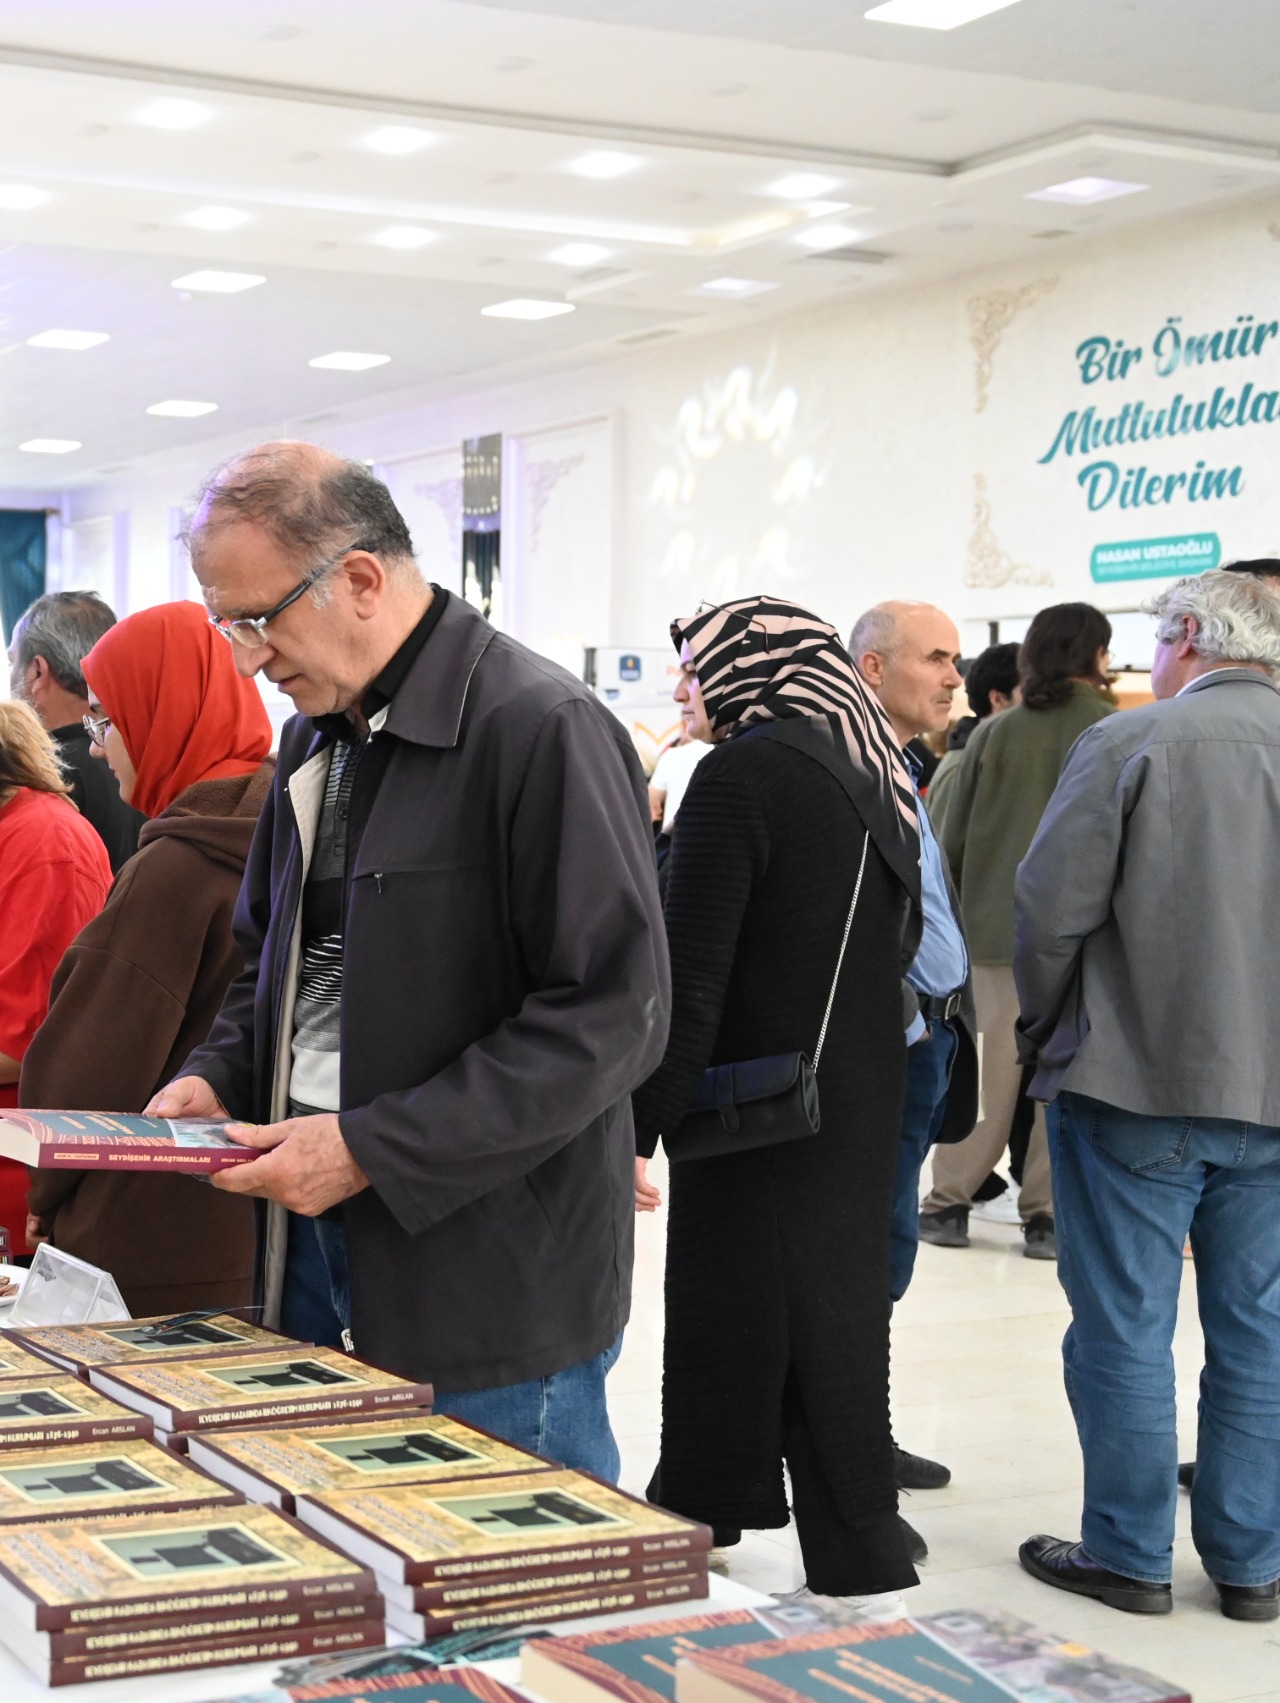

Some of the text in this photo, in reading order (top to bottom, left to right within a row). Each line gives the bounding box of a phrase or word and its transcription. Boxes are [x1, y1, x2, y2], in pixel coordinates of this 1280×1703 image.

[1076, 315, 1279, 384] Bir Ömür
[1037, 382, 1280, 464] Mutlulukla
[1077, 460, 1243, 511] Dilerim
[1096, 539, 1213, 564] HASAN USTAOĞLU
[108, 1154, 151, 1163] SEYDİŞEHİR
[153, 1154, 211, 1164] ARAŞTIRMALARI
[374, 1395, 391, 1404] Ercan
[391, 1392, 414, 1401] ARSLAN
[91, 1426, 110, 1436] Ercan
[111, 1425, 136, 1434] ARSLAN
